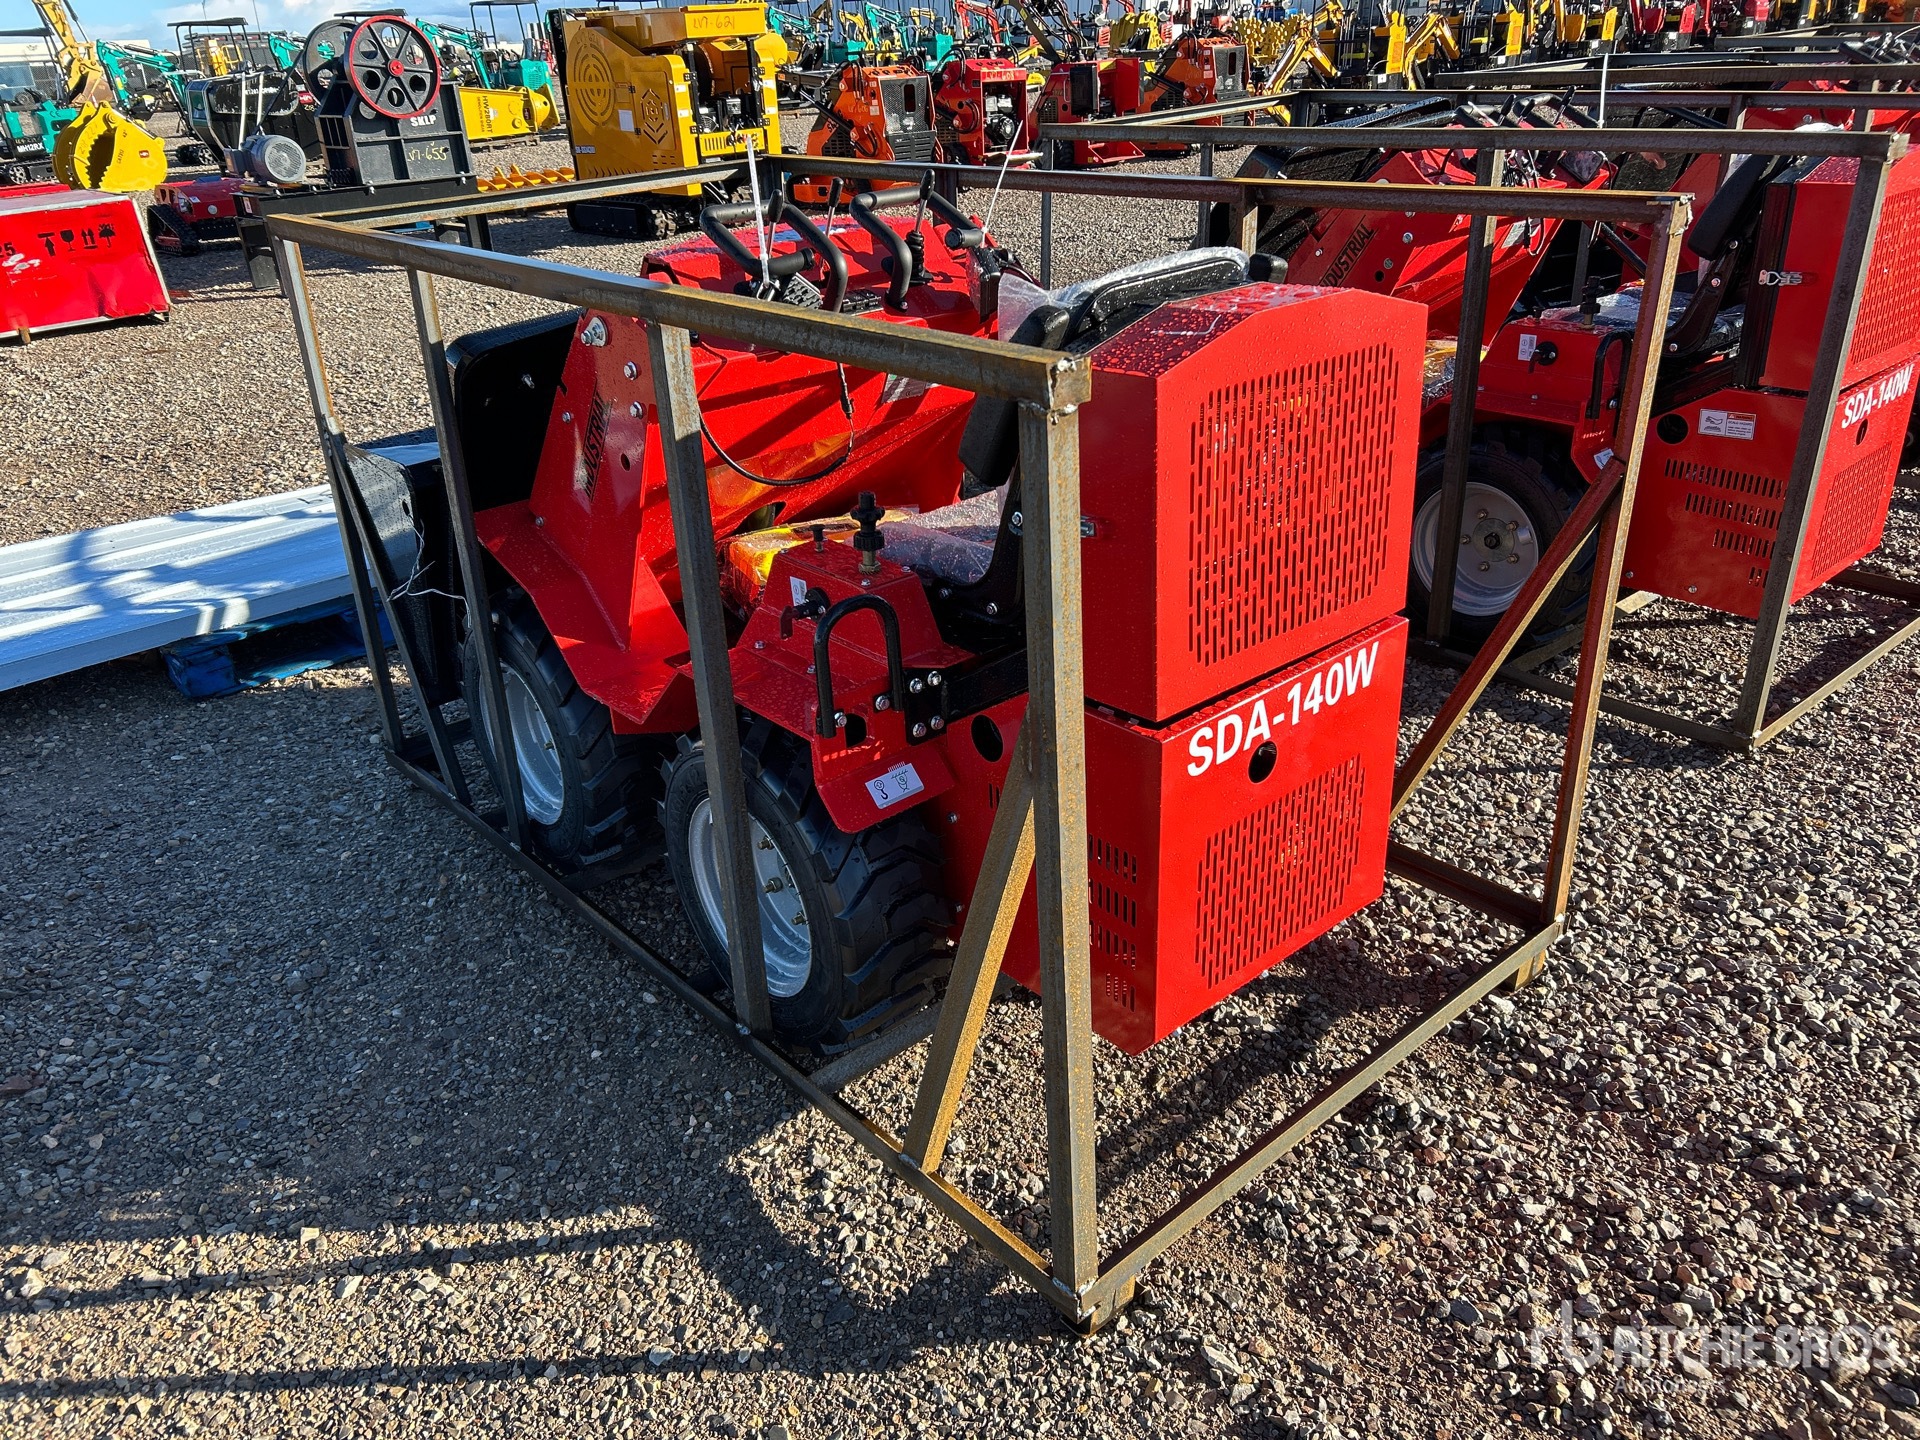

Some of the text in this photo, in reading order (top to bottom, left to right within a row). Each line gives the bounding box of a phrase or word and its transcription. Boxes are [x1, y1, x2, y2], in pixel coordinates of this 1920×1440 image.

[410, 114, 437, 127] SKLP
[482, 95, 494, 133] HW280RT
[1841, 363, 1915, 429] SDA-140W
[1187, 640, 1379, 777] SDA-140W
